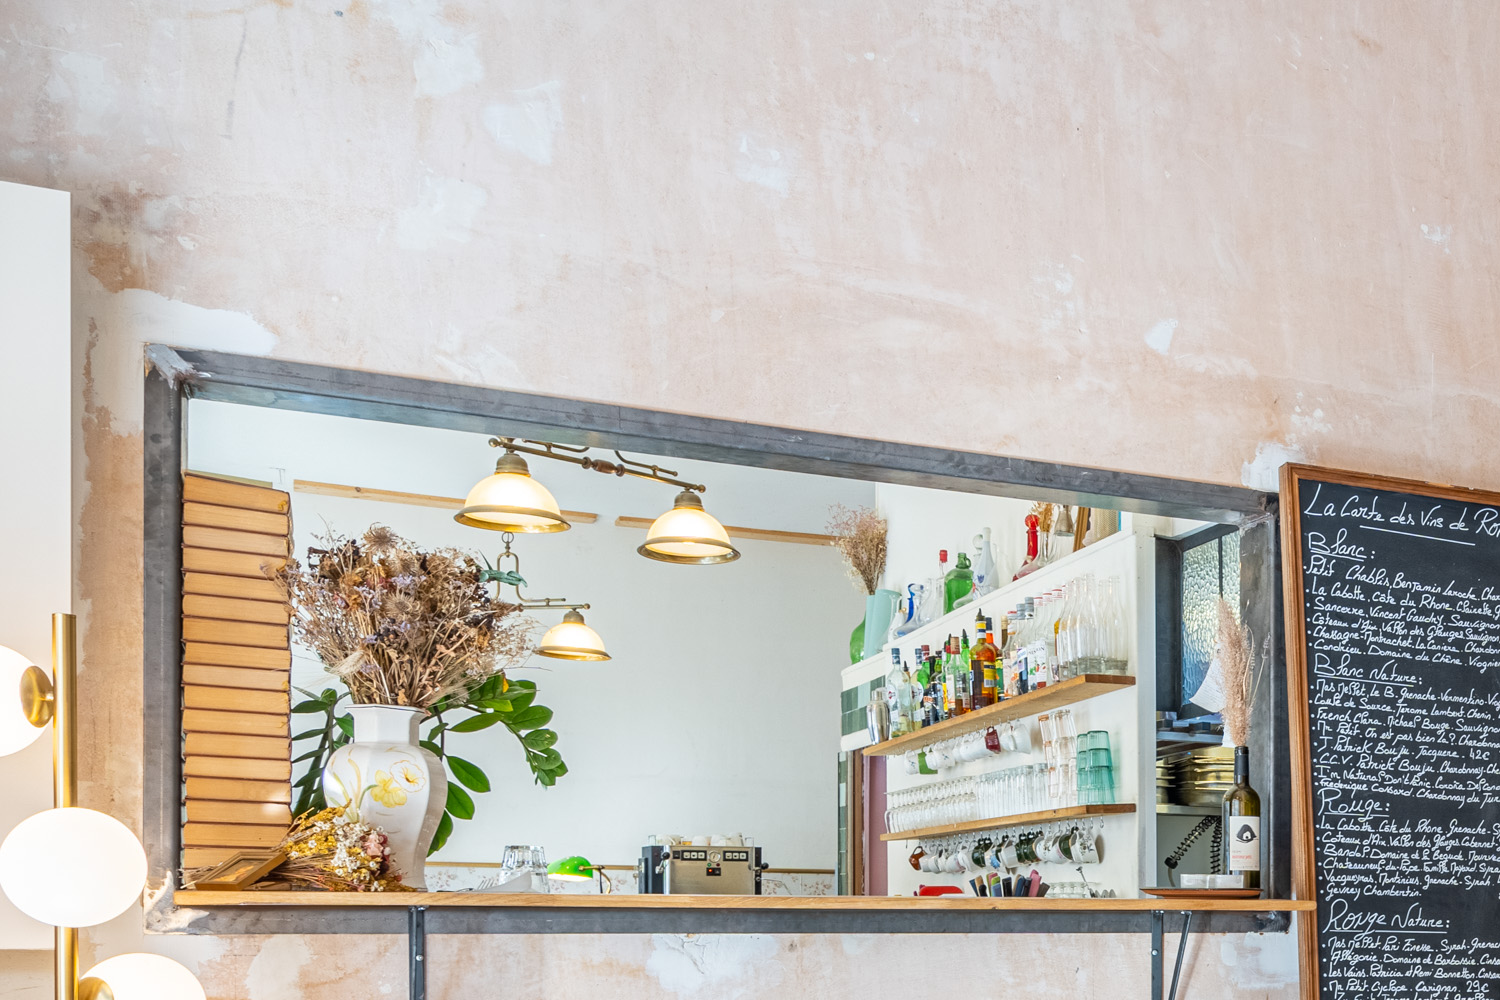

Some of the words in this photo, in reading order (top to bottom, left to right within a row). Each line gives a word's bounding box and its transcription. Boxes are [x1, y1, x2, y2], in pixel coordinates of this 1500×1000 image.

[1304, 483, 1336, 516] La
[1340, 496, 1385, 520] Carte
[1390, 502, 1415, 525] des
[1421, 505, 1443, 527] Vins
[1449, 507, 1469, 530] de
[1306, 555, 1336, 576] Petit
[1312, 576, 1327, 595] La
[1400, 593, 1416, 606] du
[1368, 645, 1412, 658] Domaine
[1415, 651, 1429, 661] du
[1314, 653, 1363, 677] Blanc
[1470, 749, 1490, 760] 42€
[1400, 820, 1411, 832] du
[1323, 899, 1386, 940] Rouge
